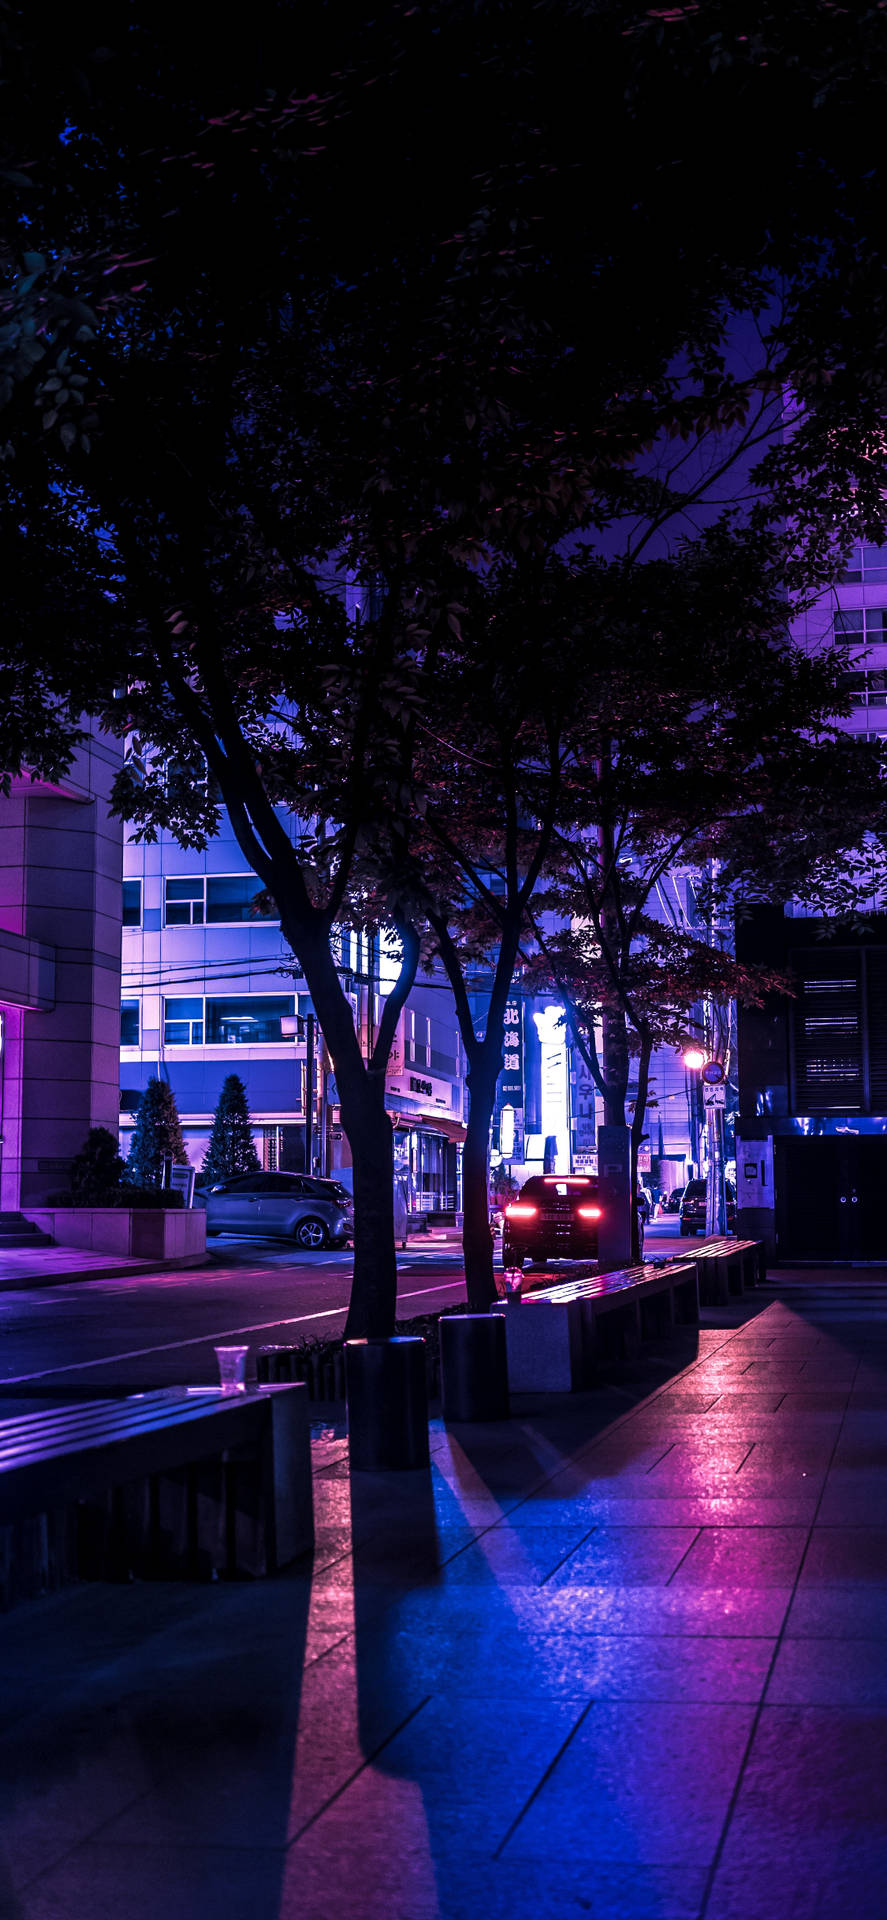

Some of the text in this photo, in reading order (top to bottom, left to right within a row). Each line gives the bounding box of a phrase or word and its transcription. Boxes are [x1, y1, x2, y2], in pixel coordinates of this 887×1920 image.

[503, 1008, 520, 1070] 北海道
[578, 1064, 594, 1120] 사우나
